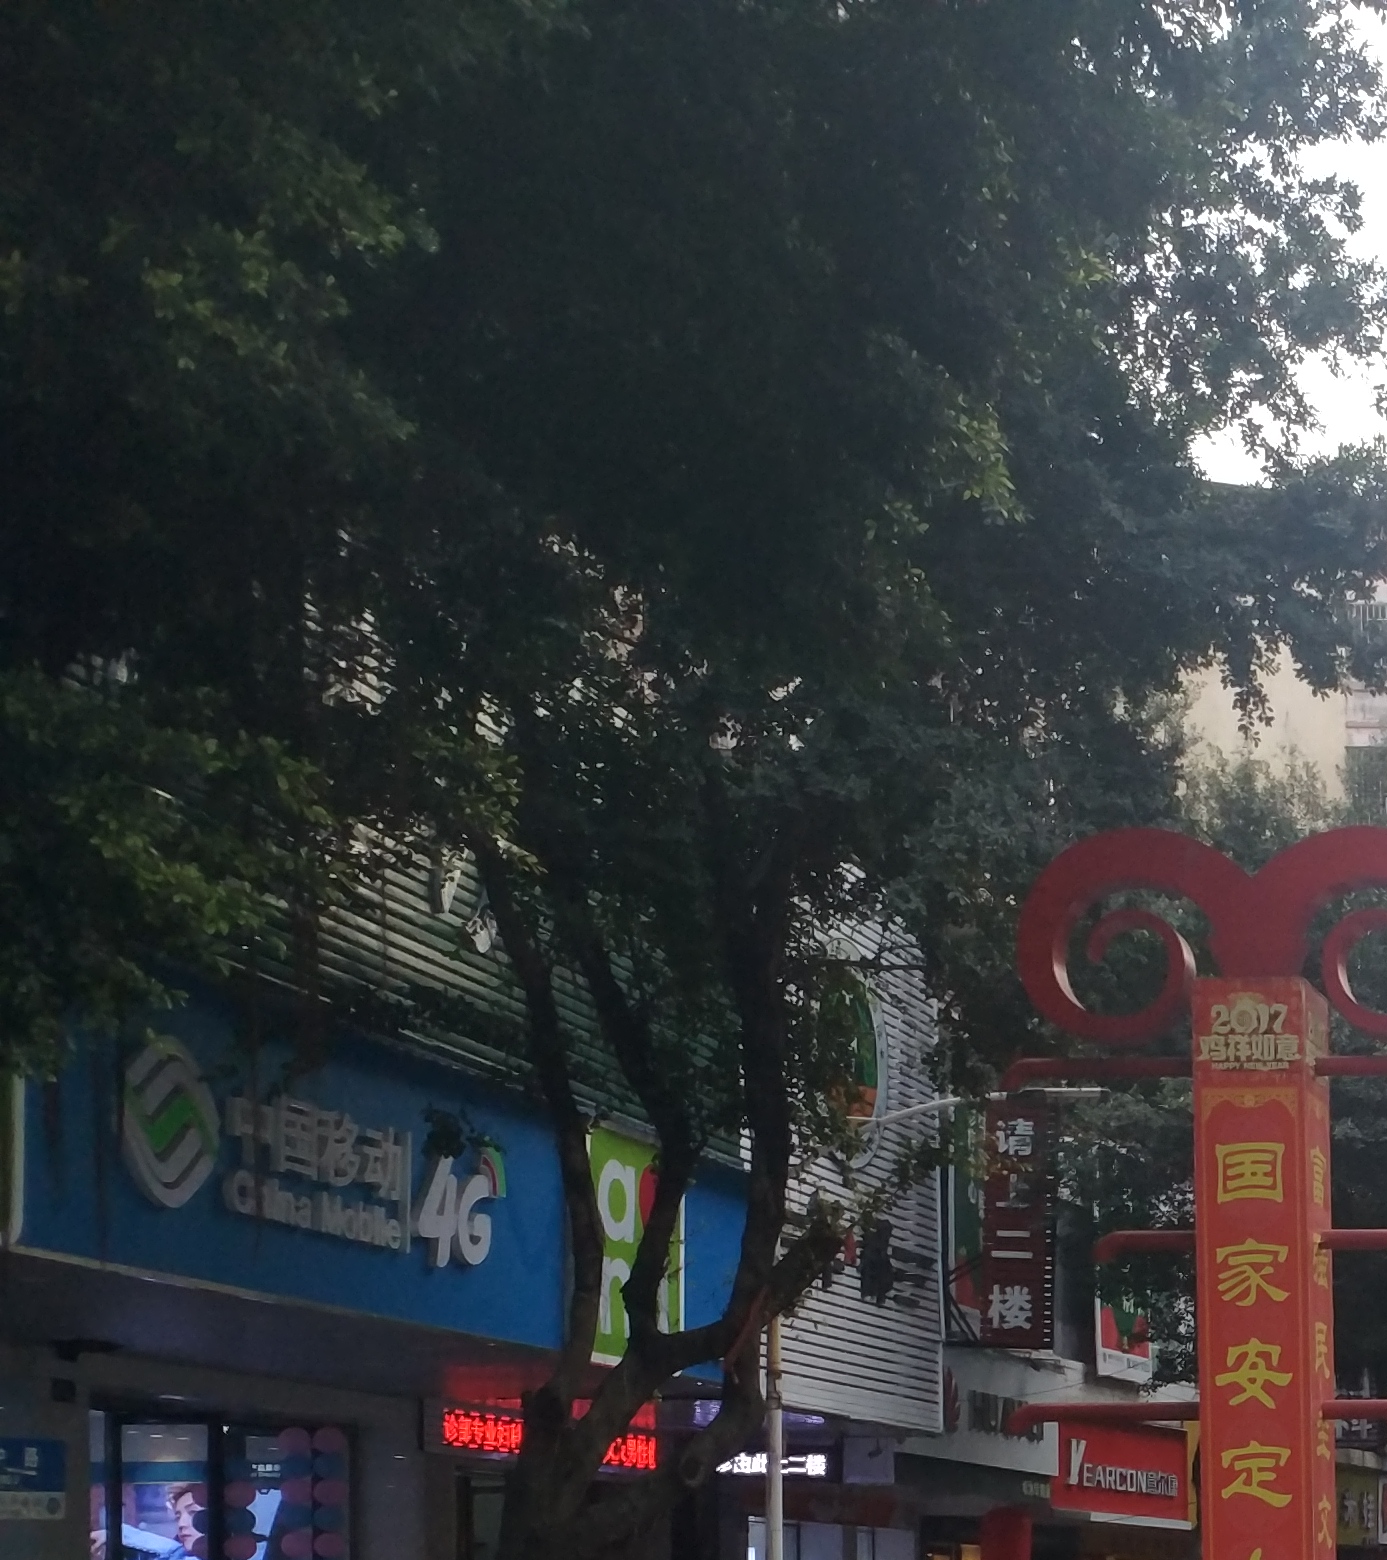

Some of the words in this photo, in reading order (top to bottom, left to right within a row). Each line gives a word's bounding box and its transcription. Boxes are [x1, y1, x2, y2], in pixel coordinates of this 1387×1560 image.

[1210, 1002, 1288, 1034] 2017
[226, 1095, 402, 1200] 中国移动
[418, 1154, 492, 1267] 4G
[716, 1452, 828, 1477] 由此二楼
